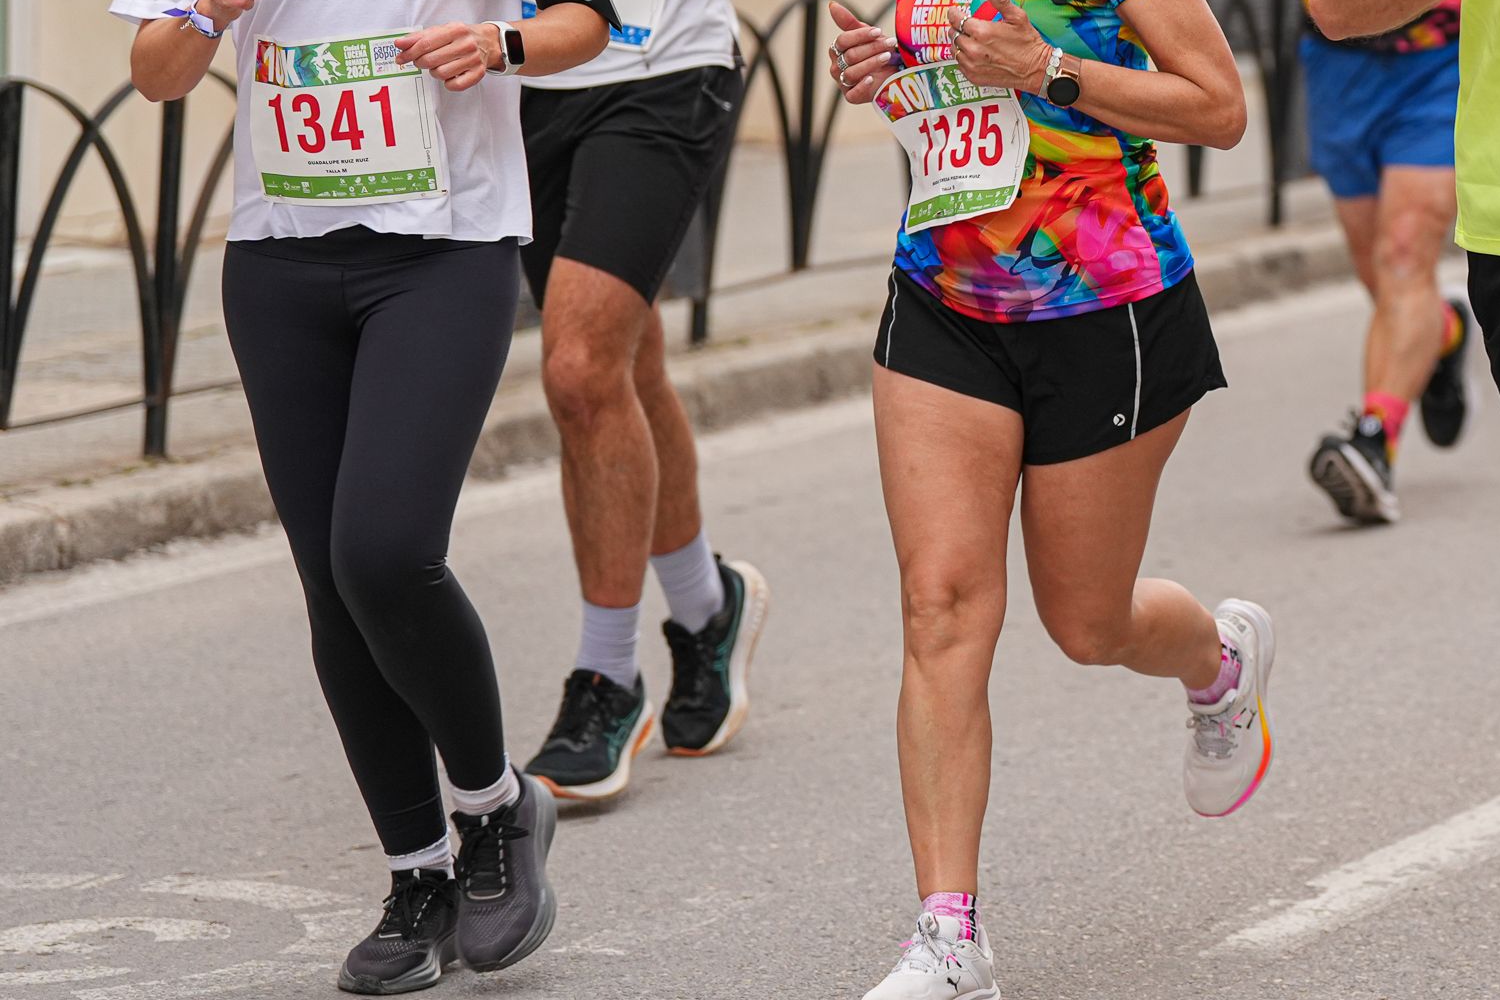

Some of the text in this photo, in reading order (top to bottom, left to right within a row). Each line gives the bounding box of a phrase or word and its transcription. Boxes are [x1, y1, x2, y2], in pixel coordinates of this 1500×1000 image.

[911, 6, 950, 25] MEDIA
[346, 65, 371, 79] 2026
[888, 72, 935, 113] 10K
[960, 87, 979, 100] 2026
[268, 85, 396, 154] 1341
[918, 104, 1003, 176] 1135
